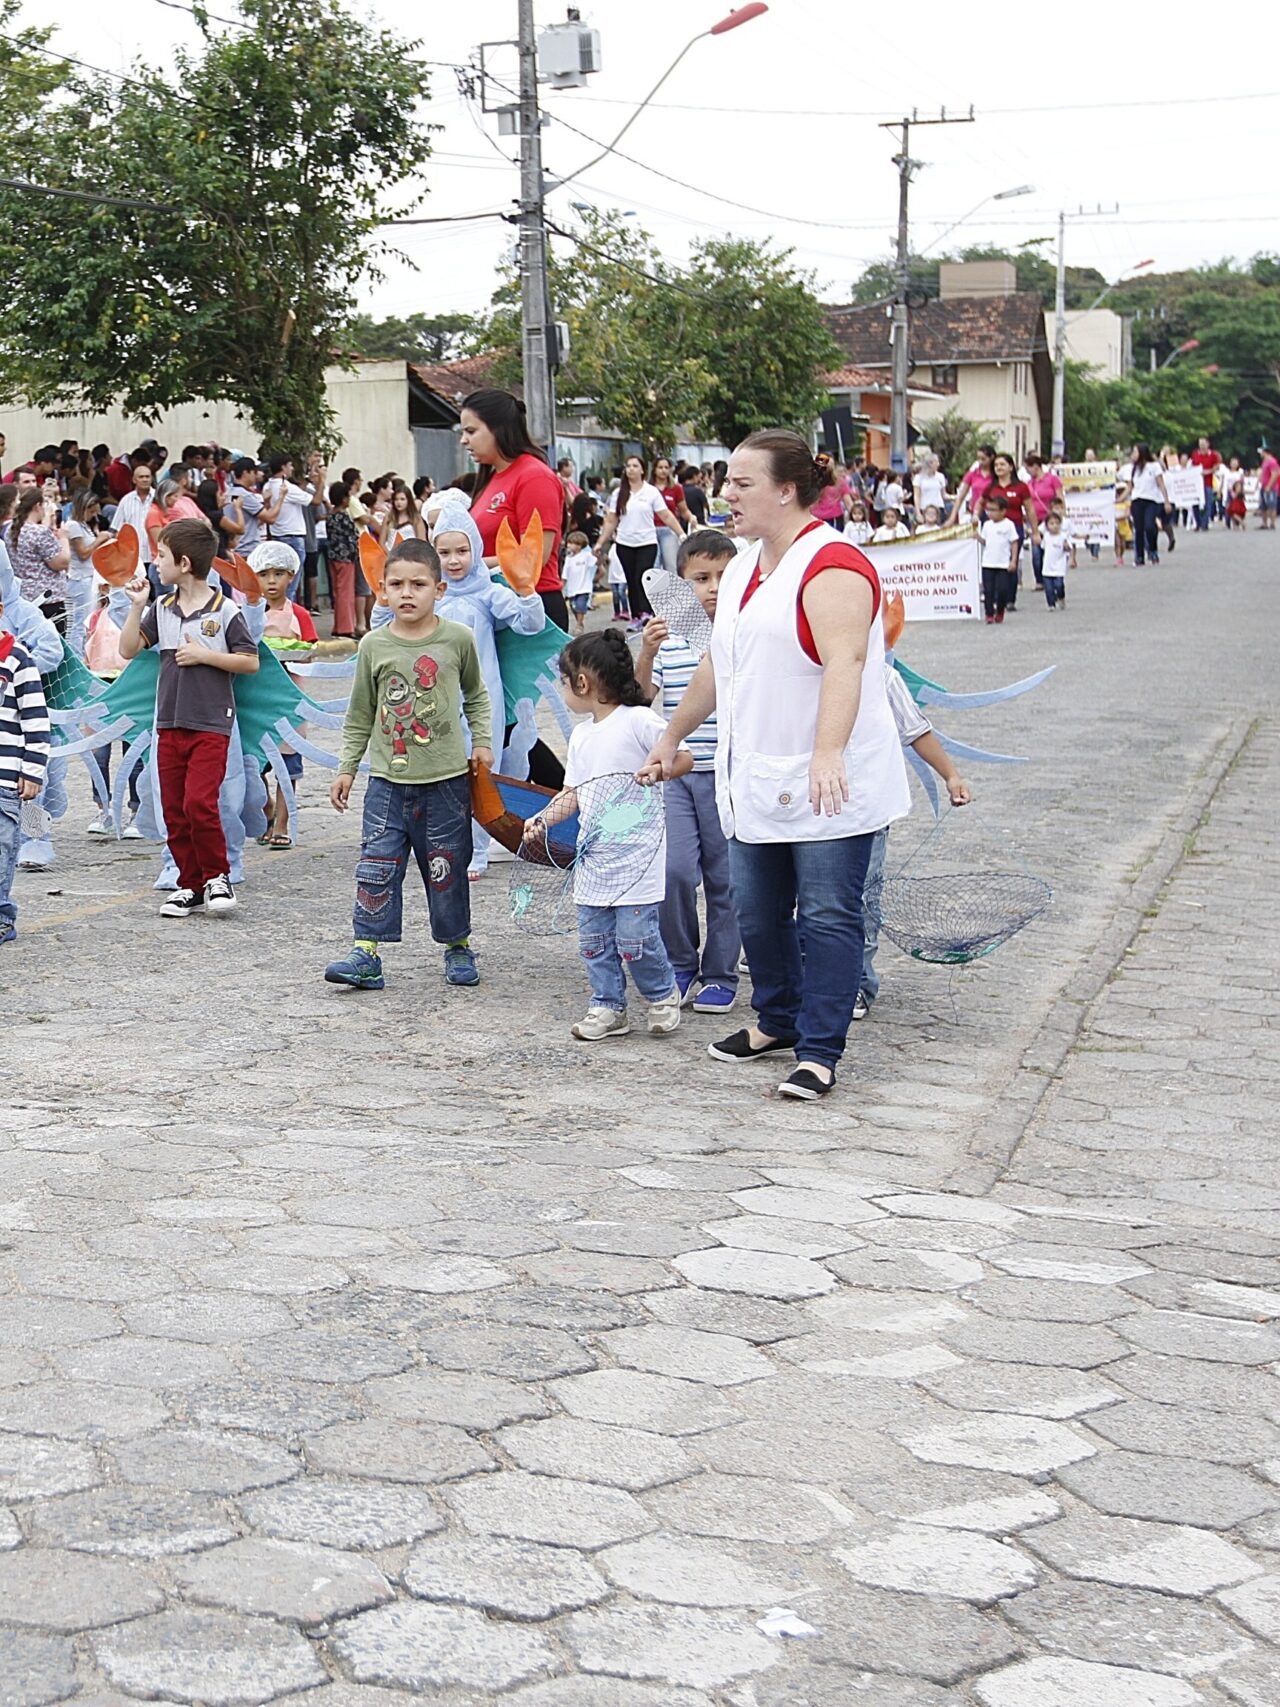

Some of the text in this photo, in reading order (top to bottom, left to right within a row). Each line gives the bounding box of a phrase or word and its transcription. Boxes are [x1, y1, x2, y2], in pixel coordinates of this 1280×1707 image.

[893, 562, 947, 572] CENTRO DE
[880, 573, 969, 586] DUCAÇÃO INFANTIL
[932, 587, 958, 596] ANJO
